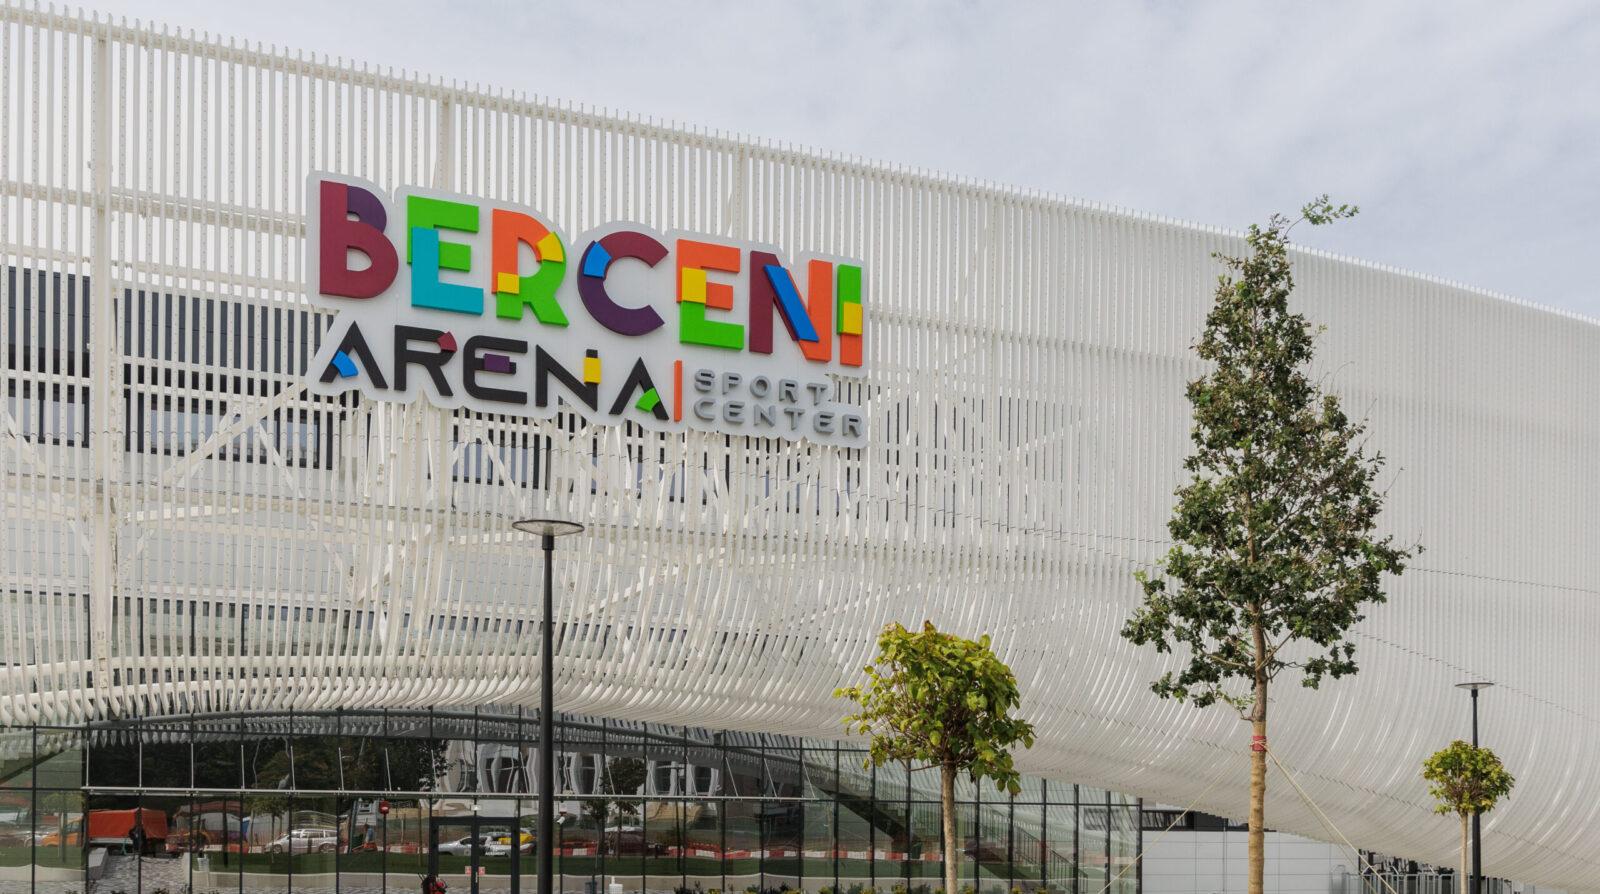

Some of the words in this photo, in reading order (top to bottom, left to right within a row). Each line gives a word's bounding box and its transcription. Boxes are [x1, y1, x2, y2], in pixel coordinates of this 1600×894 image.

[319, 179, 863, 367] BERCENI
[319, 320, 669, 421] ARENA
[694, 368, 828, 407] SPORT
[693, 397, 863, 438] CENTER
